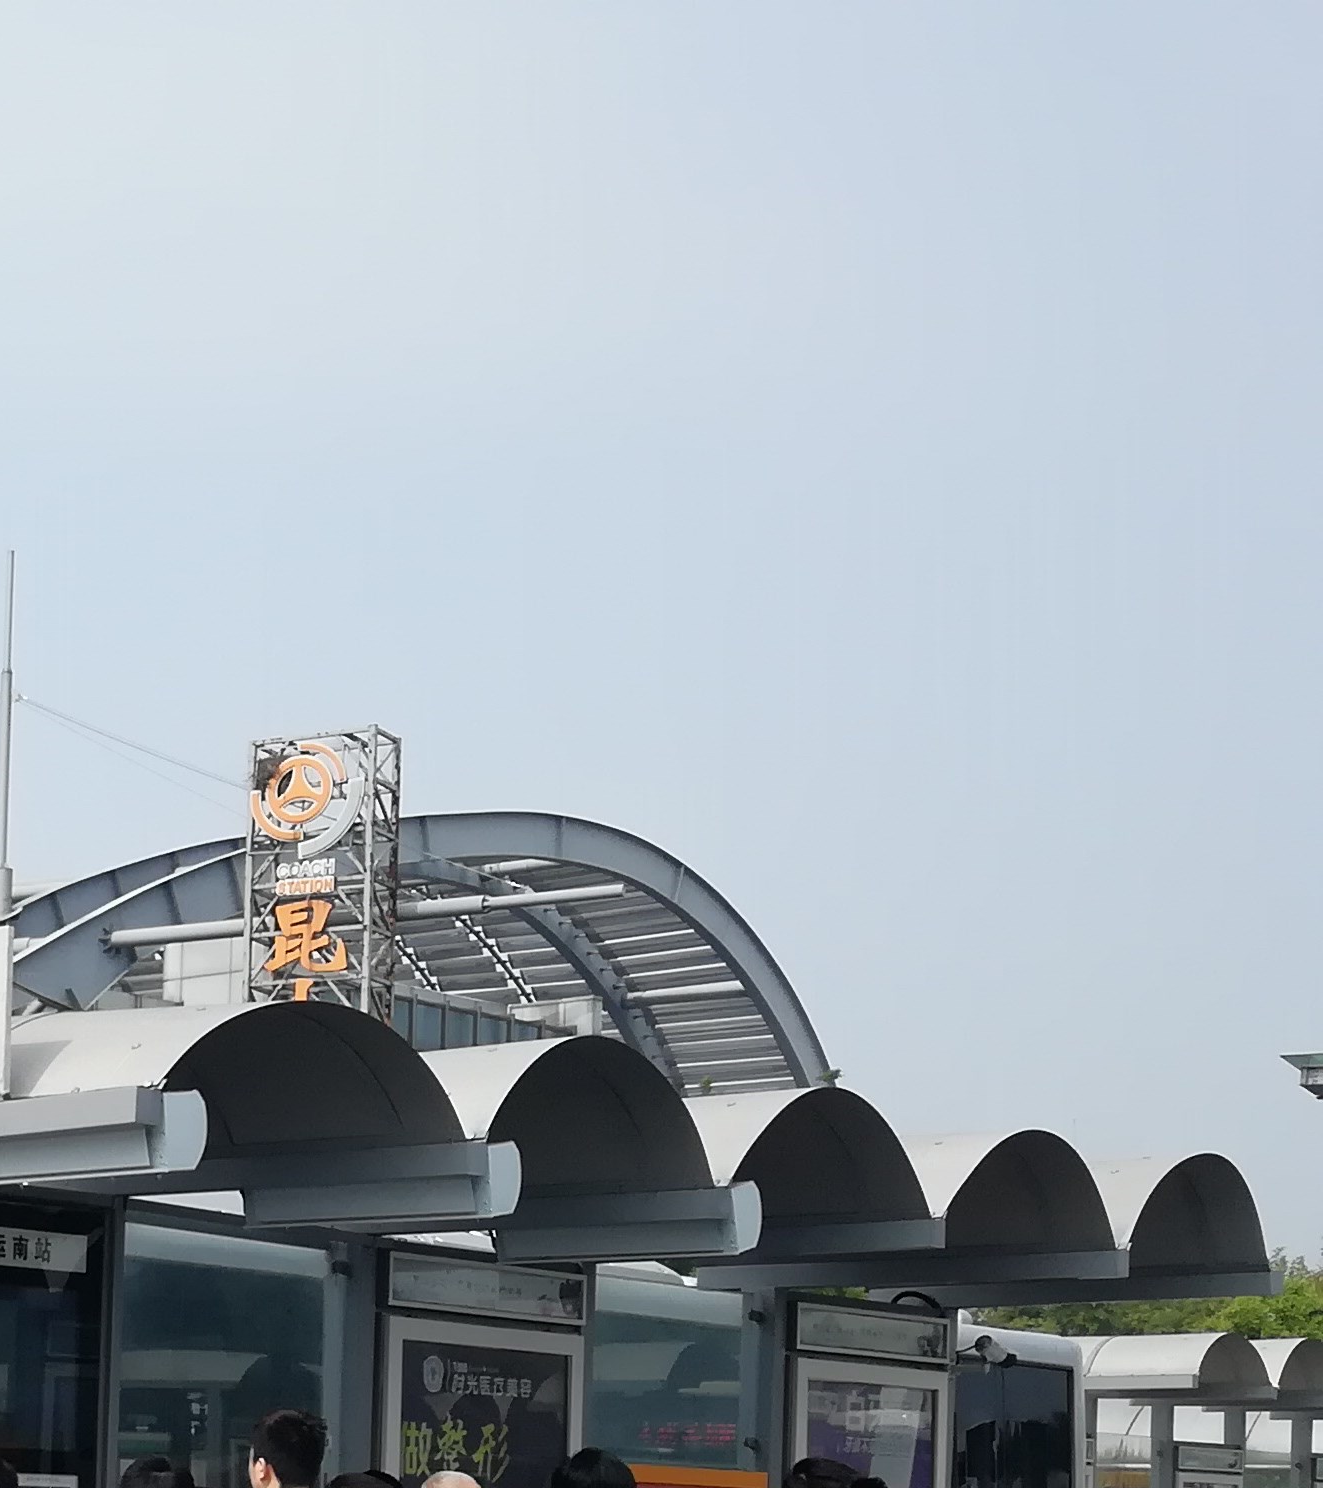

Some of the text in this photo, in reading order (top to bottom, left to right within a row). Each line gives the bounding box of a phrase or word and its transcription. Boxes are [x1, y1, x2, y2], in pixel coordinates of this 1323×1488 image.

[276, 858, 336, 879] COACH
[275, 876, 335, 896] STATION
[263, 899, 348, 1001] 昆
